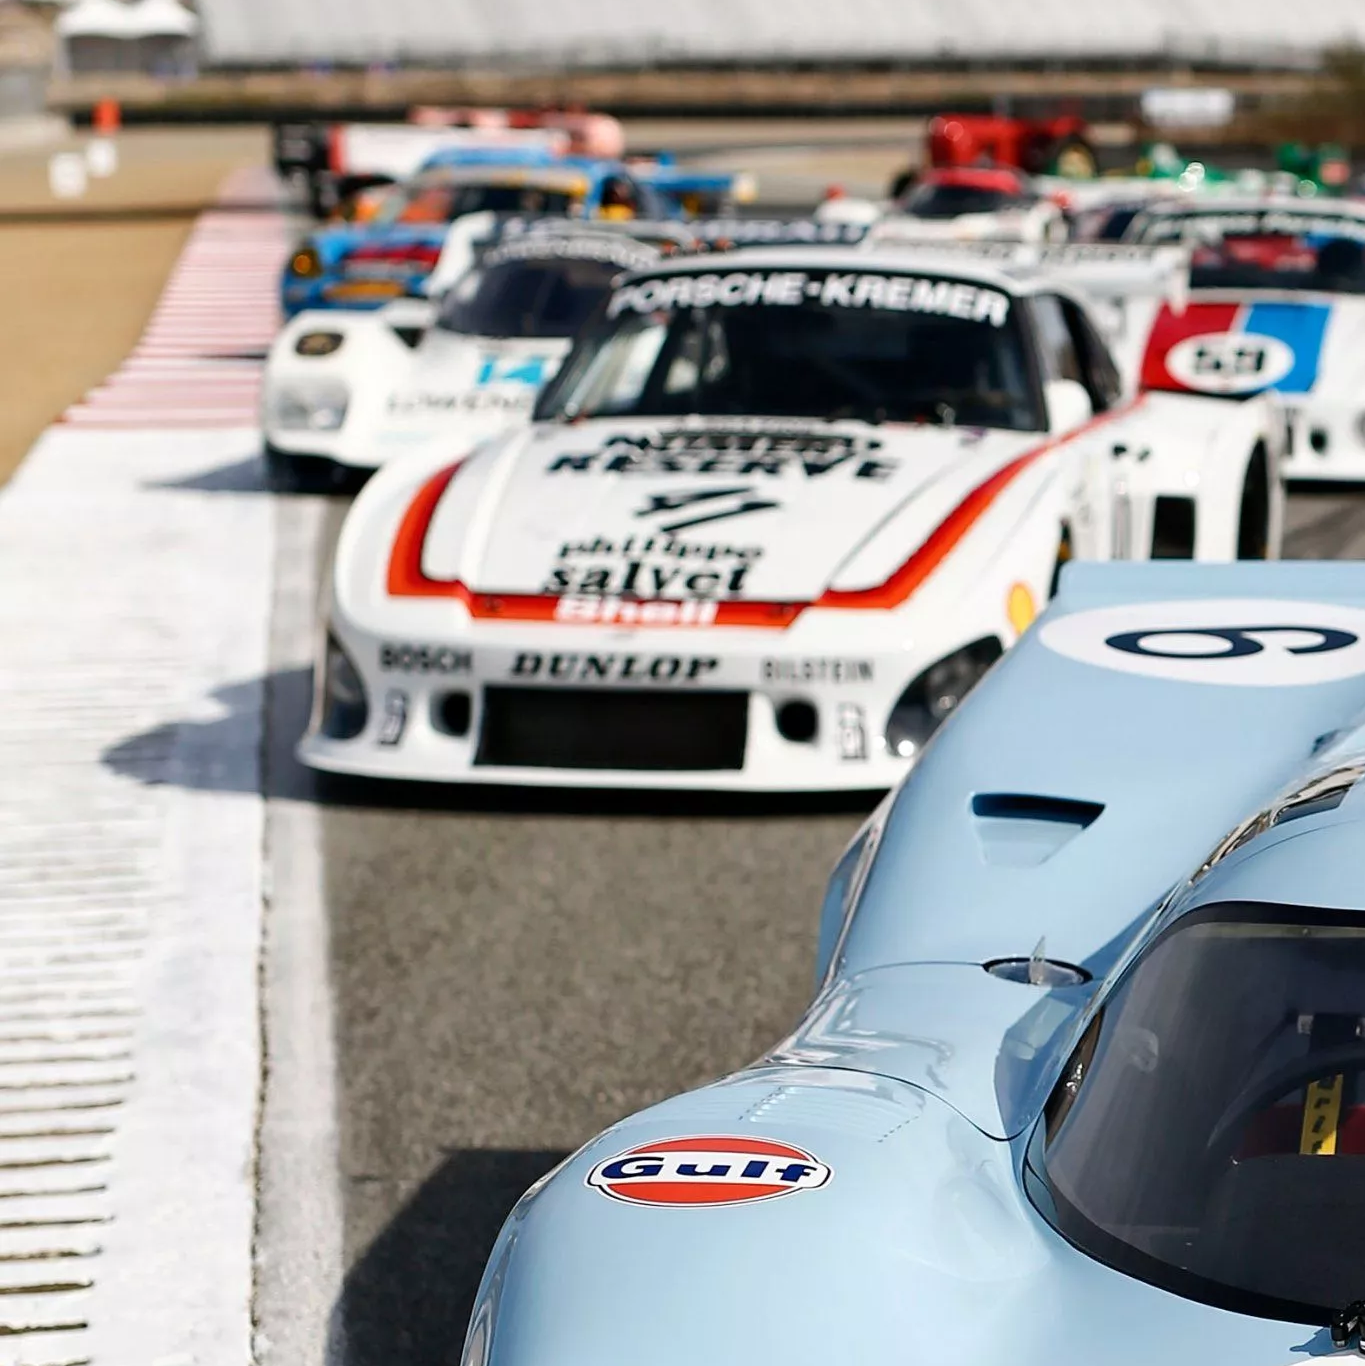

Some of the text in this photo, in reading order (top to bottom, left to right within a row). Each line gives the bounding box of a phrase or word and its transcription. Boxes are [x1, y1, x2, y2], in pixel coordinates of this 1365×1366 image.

[556, 596, 719, 623] Shell
[380, 645, 474, 673] BOSCH
[510, 651, 721, 681] DUNLOP
[762, 657, 876, 684] BILSTEIN
[601, 1156, 817, 1183] Gulf
